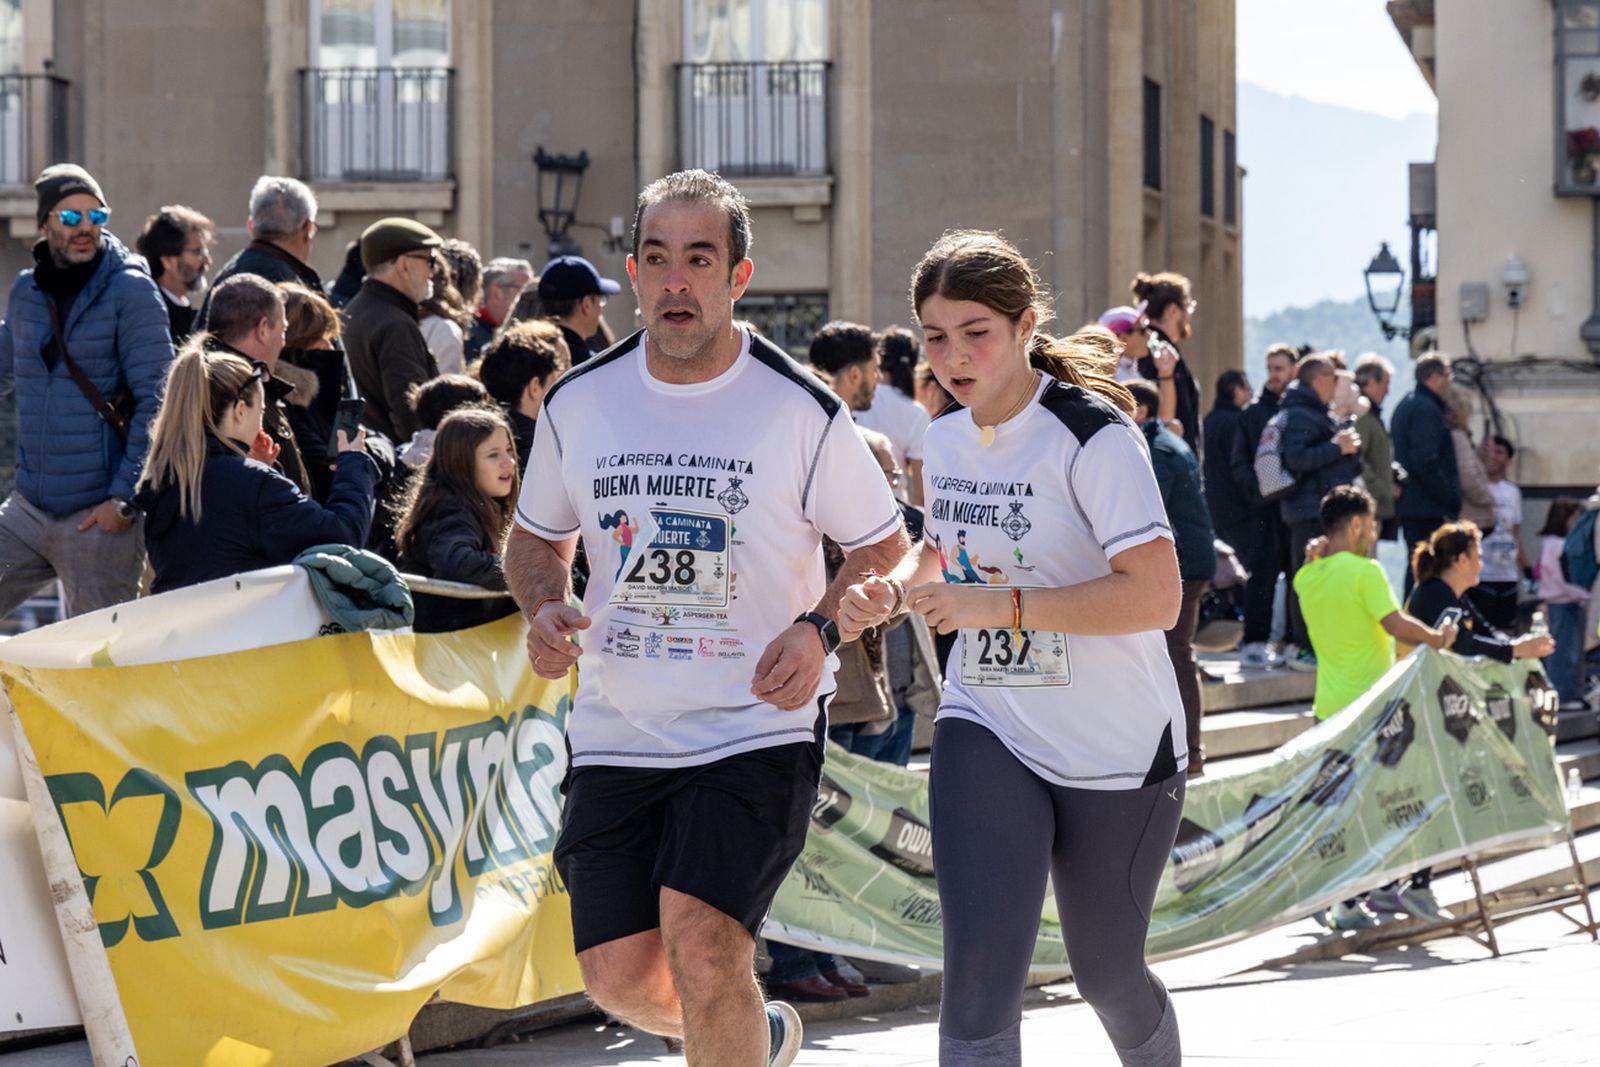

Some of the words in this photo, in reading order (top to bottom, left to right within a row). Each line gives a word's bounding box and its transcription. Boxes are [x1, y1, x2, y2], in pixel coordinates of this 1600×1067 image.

[596, 457, 606, 469] VI
[609, 453, 673, 467] CARRERA
[678, 454, 754, 475] CAMINATA
[593, 474, 640, 499] BUENA
[646, 475, 717, 499] MUERTE
[665, 517, 712, 530] CAMINATA
[953, 500, 999, 527] MUERTE
[623, 549, 696, 585] 238
[977, 629, 1036, 666] 237
[188, 703, 571, 920] masyma
